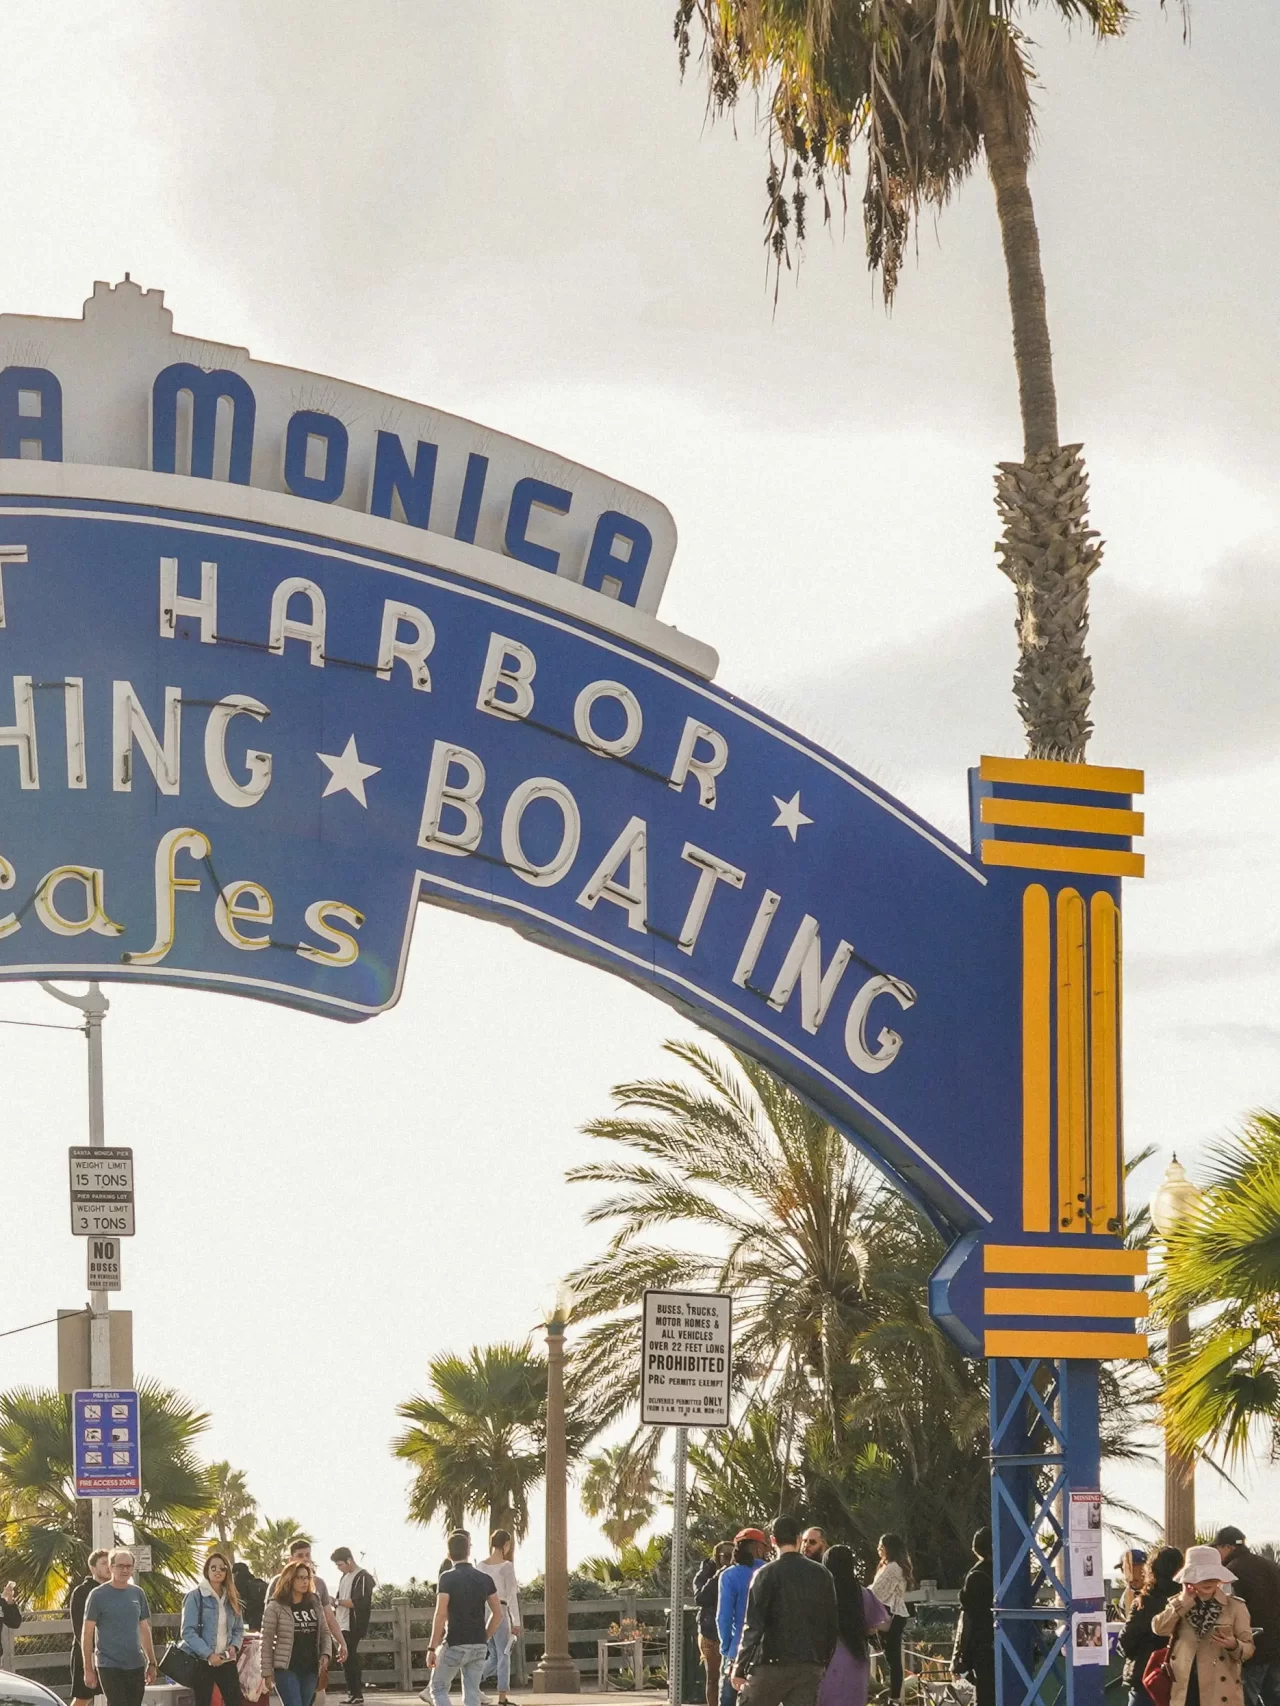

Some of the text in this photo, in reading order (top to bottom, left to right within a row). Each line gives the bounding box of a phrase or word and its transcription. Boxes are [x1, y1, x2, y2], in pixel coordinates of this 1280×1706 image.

[152, 362, 652, 608] MONICA
[160, 557, 728, 810] HARBOR
[417, 740, 917, 1074] BOATING
[108, 1162, 127, 1170] LIMIT
[76, 1174, 128, 1187] 15 TONS
[77, 1205, 128, 1213] WEIGHT LIMIT
[80, 1217, 127, 1230] 3 TONS
[94, 1241, 115, 1260] NO
[90, 1262, 118, 1273] BUSES
[657, 1304, 719, 1317] BUSES, TRUCKS,
[655, 1316, 719, 1329] MOTOR HOMES &
[661, 1329, 714, 1341] ALL VEHICLES
[649, 1341, 725, 1354] OVER 22 FEET LONG
[648, 1354, 725, 1373] PROHIBITED
[648, 1374, 724, 1387] PRC PERMITS EXEMPT
[648, 1395, 723, 1407] DELIVERIES PERMITTED ONLY
